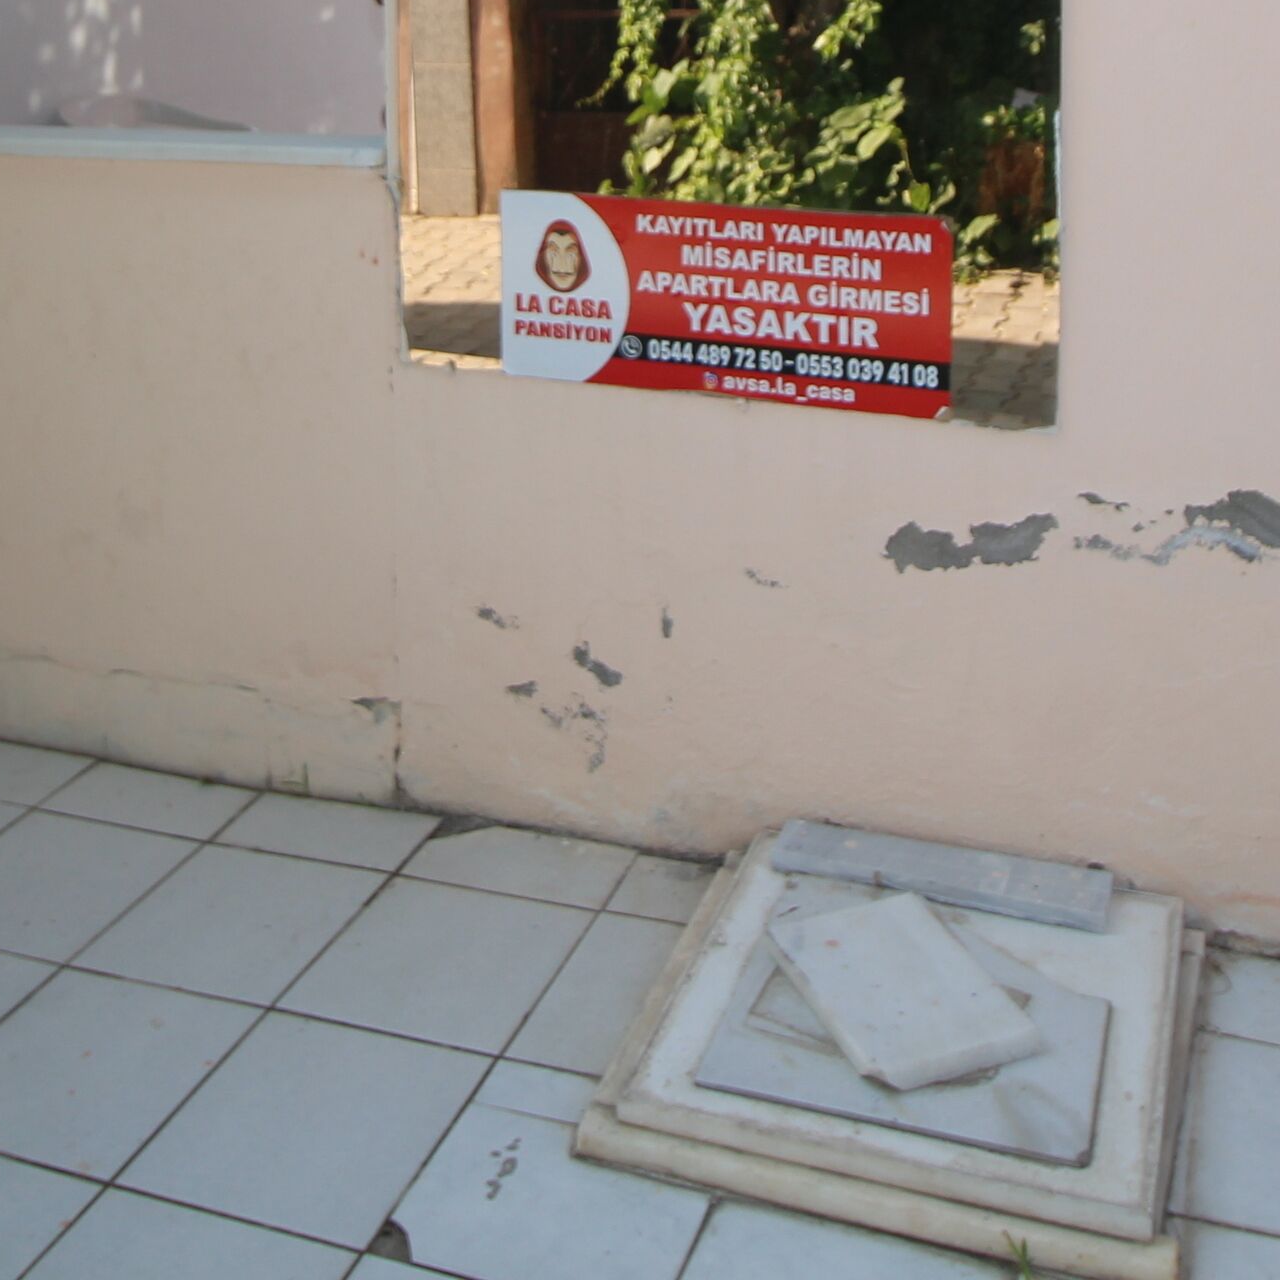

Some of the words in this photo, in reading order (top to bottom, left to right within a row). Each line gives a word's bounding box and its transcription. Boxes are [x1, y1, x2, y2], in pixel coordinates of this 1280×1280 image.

[635, 213, 765, 242] KAYITLARI
[771, 222, 933, 254] YAPILMAYAN
[681, 240, 883, 282] MİSAFİRLERİN
[515, 292, 542, 314] LA
[548, 295, 612, 320] CASA
[636, 269, 801, 306] APARTLARA
[807, 280, 930, 317] GİRMESİ
[515, 318, 612, 344] PANSİYON
[682, 301, 880, 349] YASAKTIR
[648, 337, 694, 364] 0544
[696, 342, 732, 368] 489
[734, 347, 757, 370] 72
[846, 357, 885, 384] 039
[887, 361, 910, 385] 41
[912, 363, 939, 389] 08
